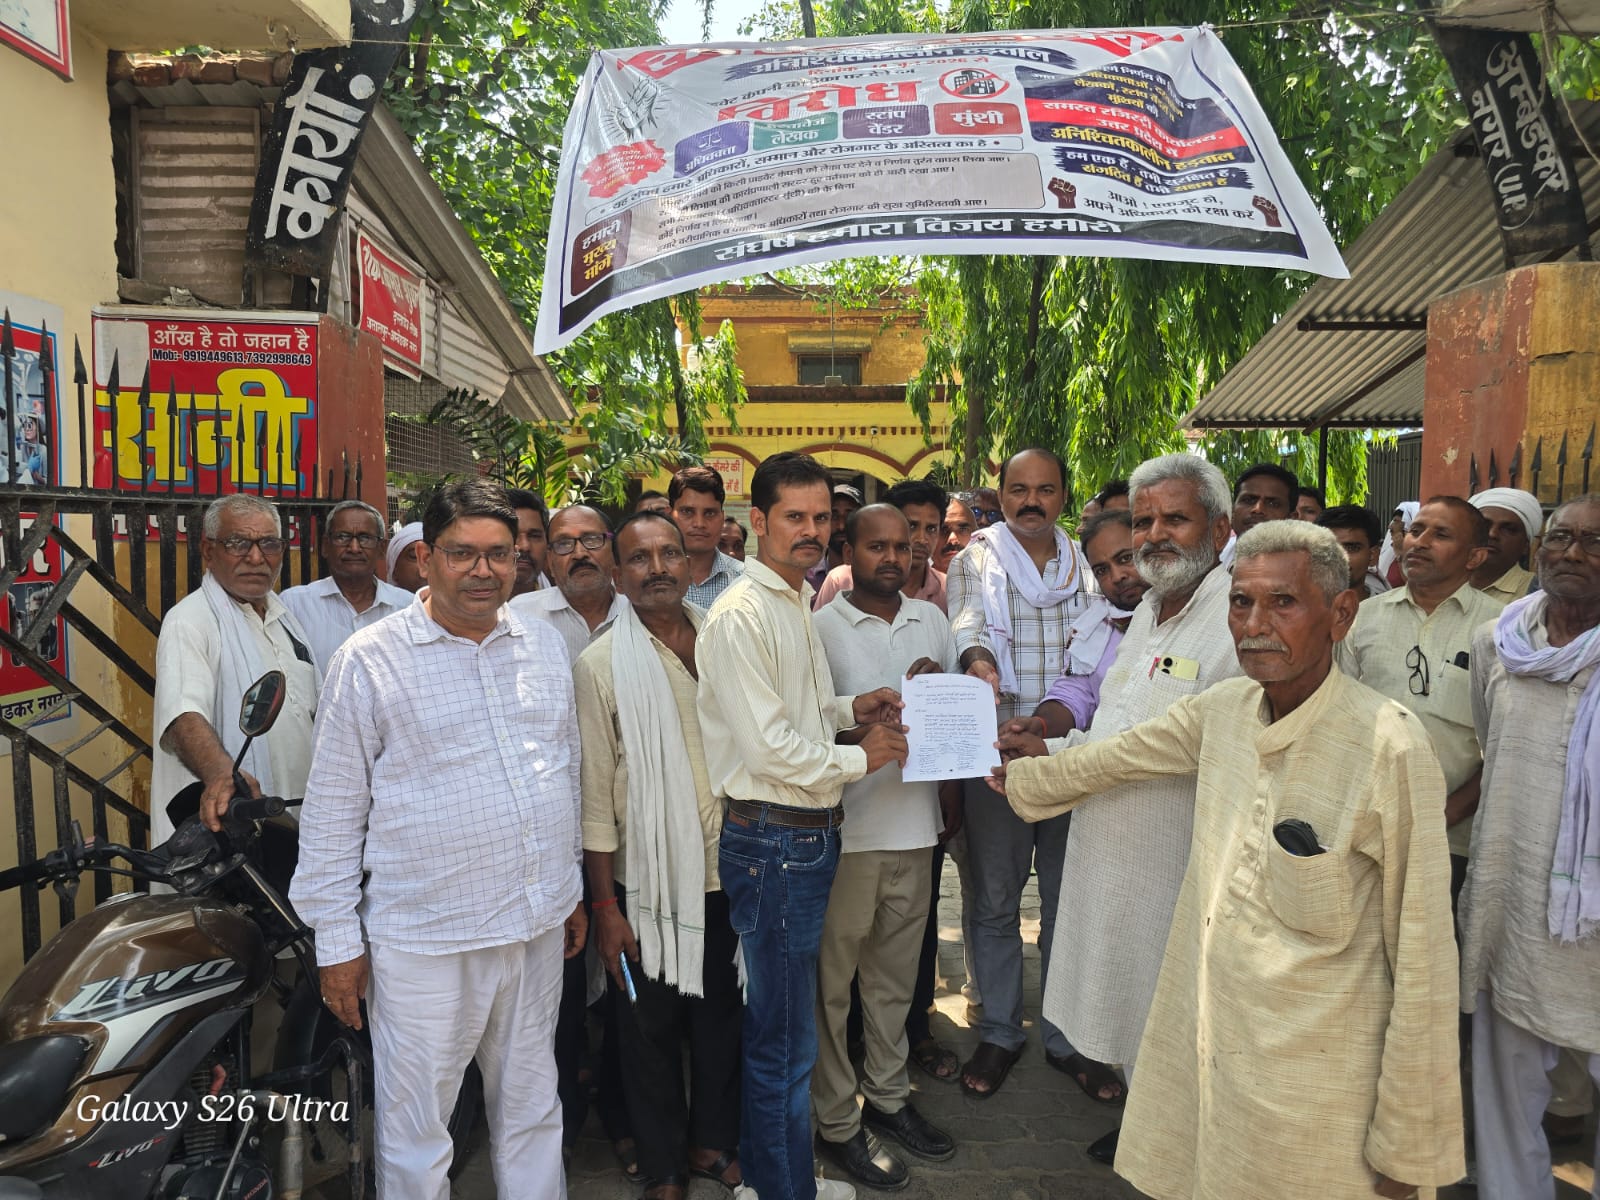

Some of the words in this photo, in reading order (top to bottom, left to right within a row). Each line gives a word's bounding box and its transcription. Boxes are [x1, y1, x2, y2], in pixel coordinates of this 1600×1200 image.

[951, 110, 1004, 128] मुंशी
[770, 128, 820, 146] लेखक
[801, 146, 828, 158] और
[884, 139, 898, 150] के
[914, 216, 1014, 235] विजय
[154, 323, 196, 347] आँख
[197, 325, 214, 348] है
[217, 325, 239, 348] तो
[242, 331, 292, 350] जहान
[294, 327, 311, 351] है
